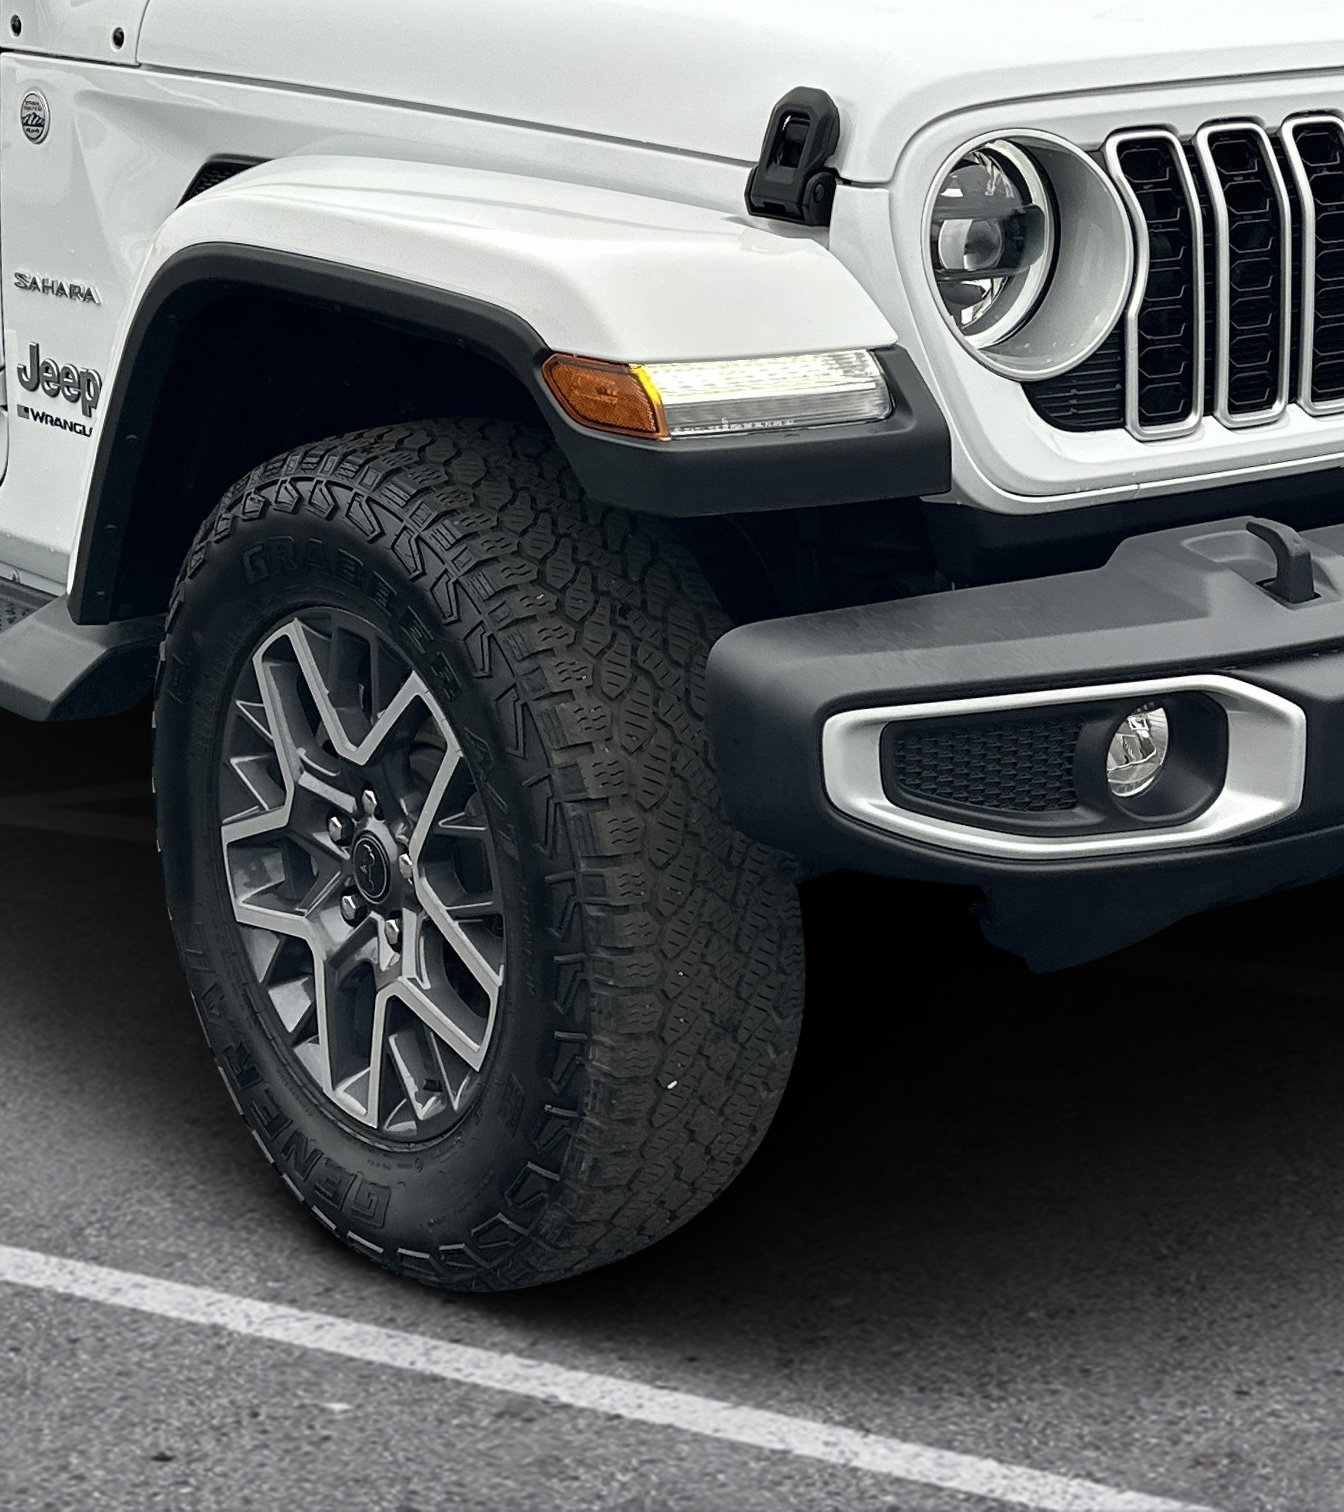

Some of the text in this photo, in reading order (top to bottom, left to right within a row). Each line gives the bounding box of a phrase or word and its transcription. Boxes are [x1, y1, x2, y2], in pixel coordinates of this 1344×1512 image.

[14, 271, 102, 305] SAHARA
[17, 342, 102, 418] Jeep
[30, 407, 93, 438] WRANGL
